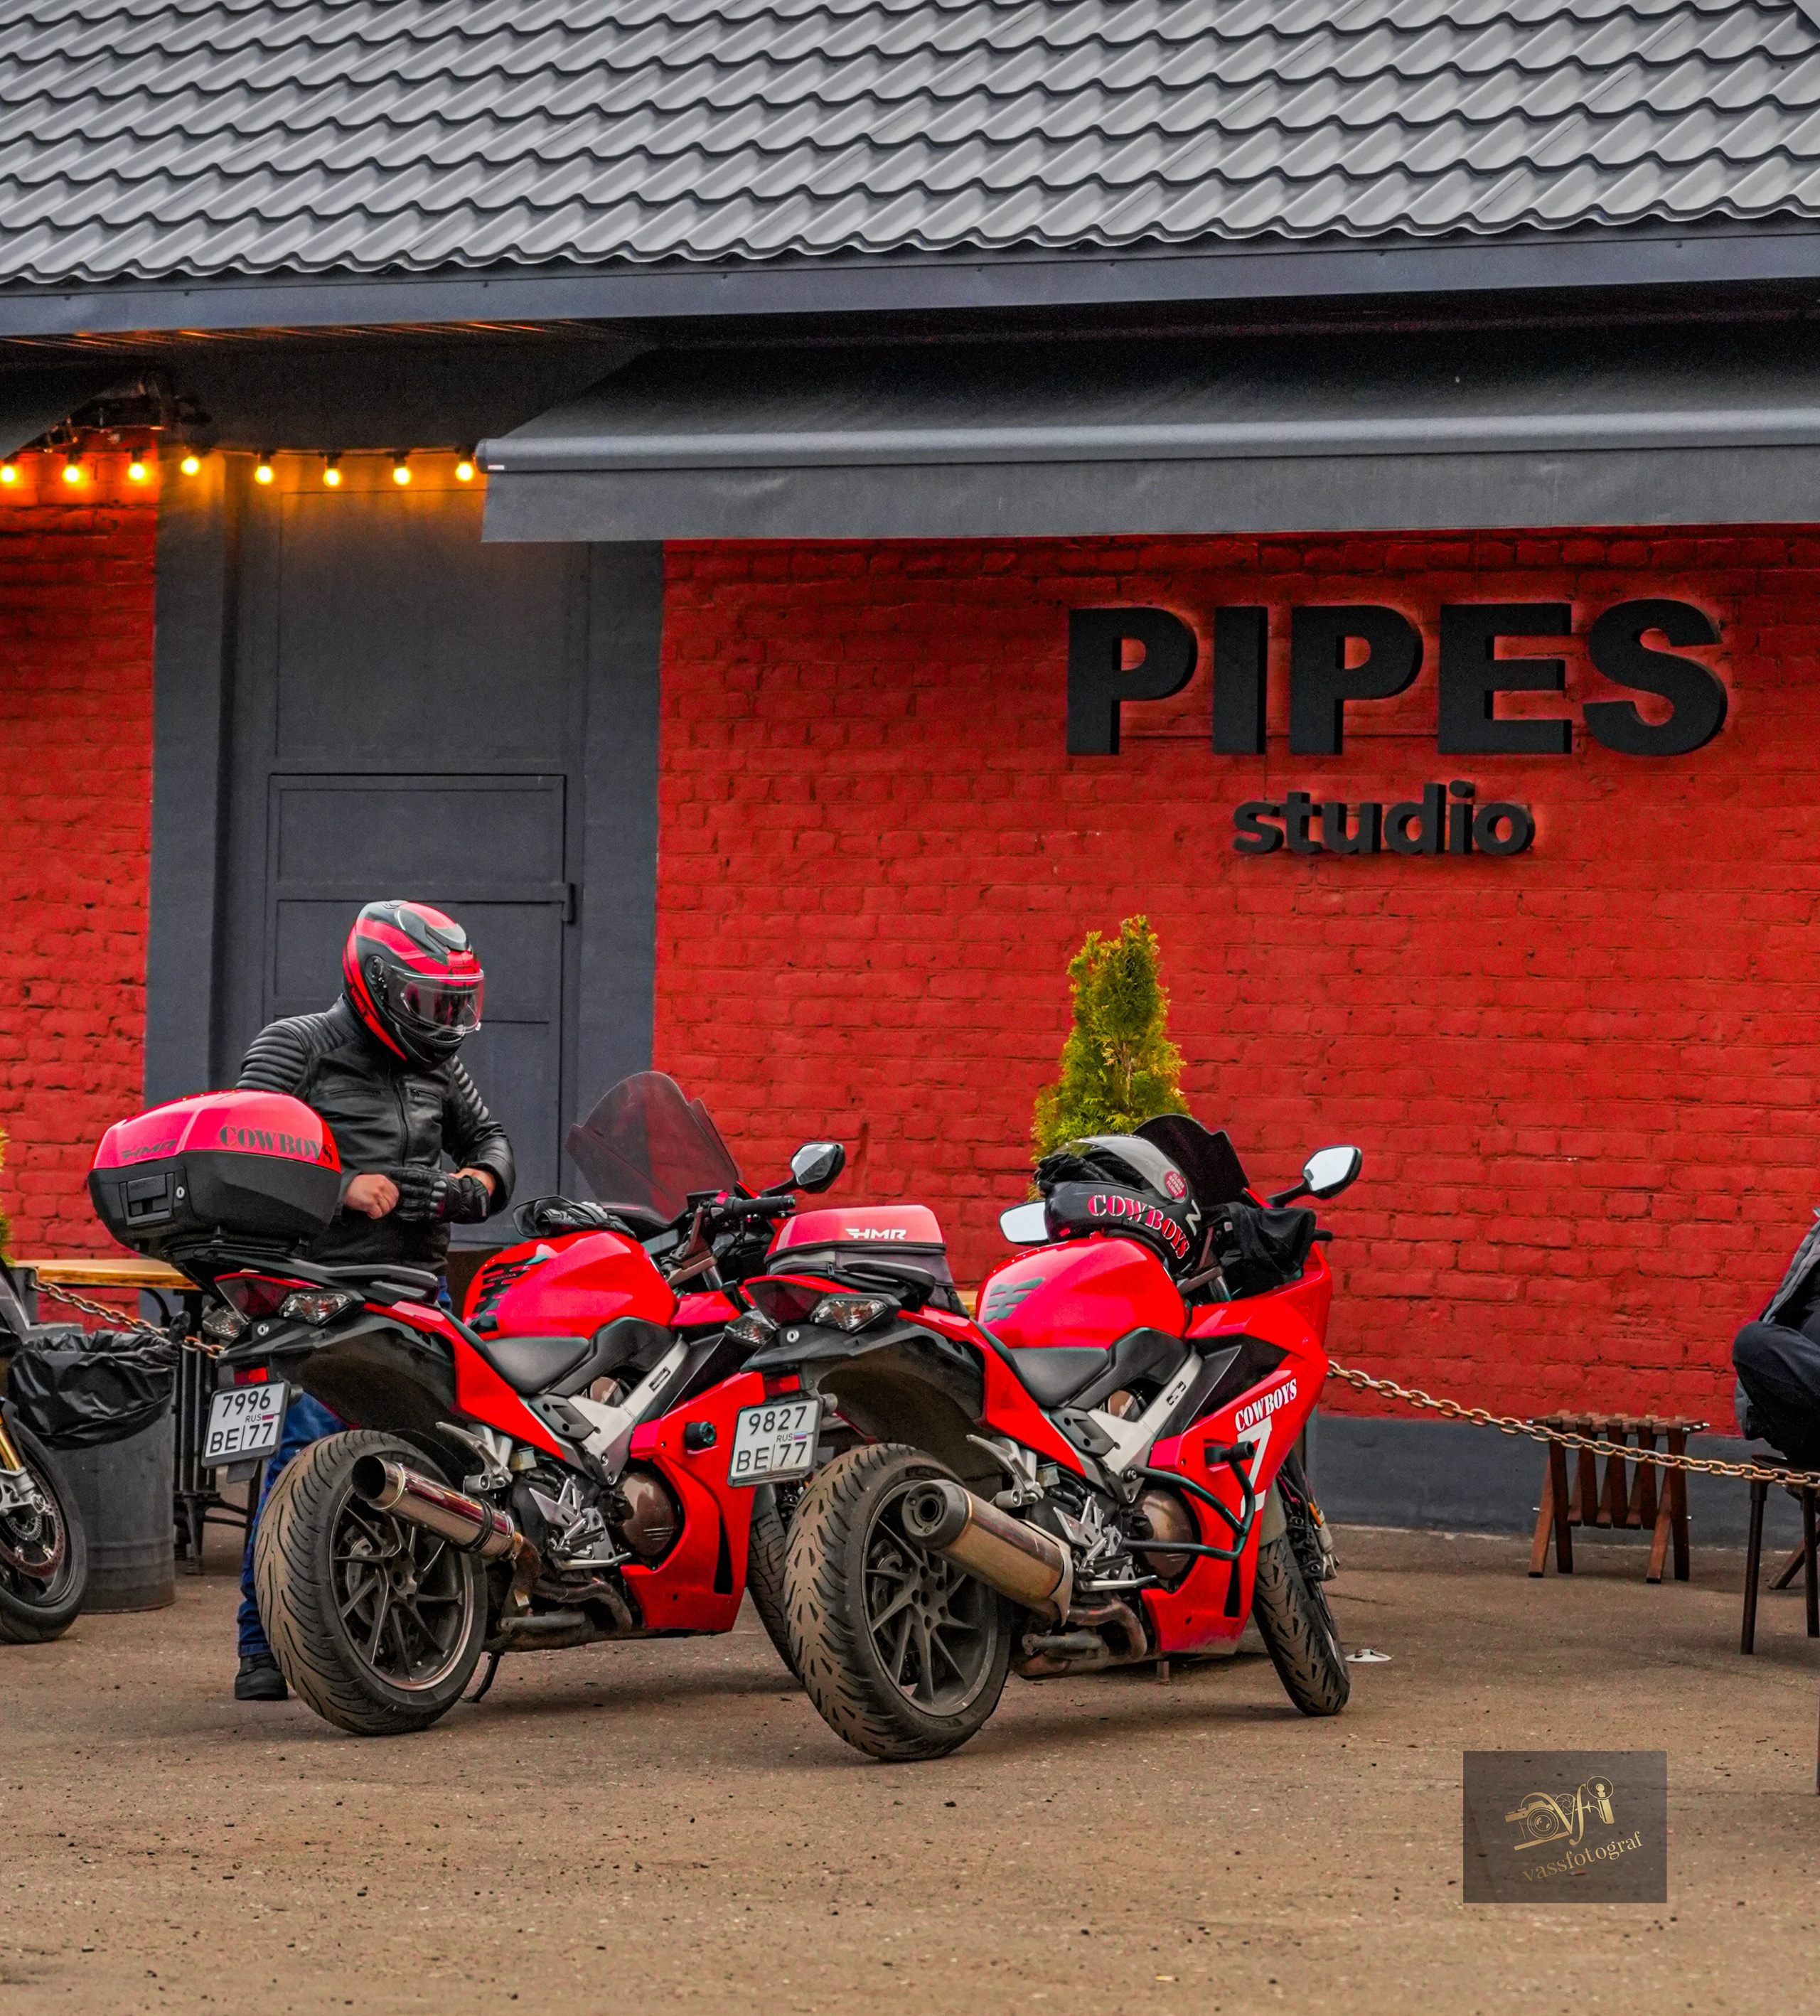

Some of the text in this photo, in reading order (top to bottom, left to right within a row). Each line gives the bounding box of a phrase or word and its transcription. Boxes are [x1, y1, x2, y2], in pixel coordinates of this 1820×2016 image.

[1067, 599, 1728, 757] PIPES
[1233, 780, 1535, 855] studio
[219, 1125, 333, 1165] COWBOYS
[1166, 1180, 1179, 1196] FLIGHT
[1168, 1175, 1183, 1194] BEFORE
[1172, 1173, 1185, 1189] CLOSE
[845, 1228, 907, 1240] HMR
[1088, 1194, 1190, 1260] COWBOYS
[222, 1388, 271, 1417] 7996
[1235, 1378, 1297, 1432] COWBOYS
[245, 1413, 262, 1423] RUS
[749, 1405, 807, 1435] 9827
[209, 1422, 273, 1454] BE 77
[776, 1433, 793, 1443] RUS
[736, 1441, 807, 1473] BE 77
